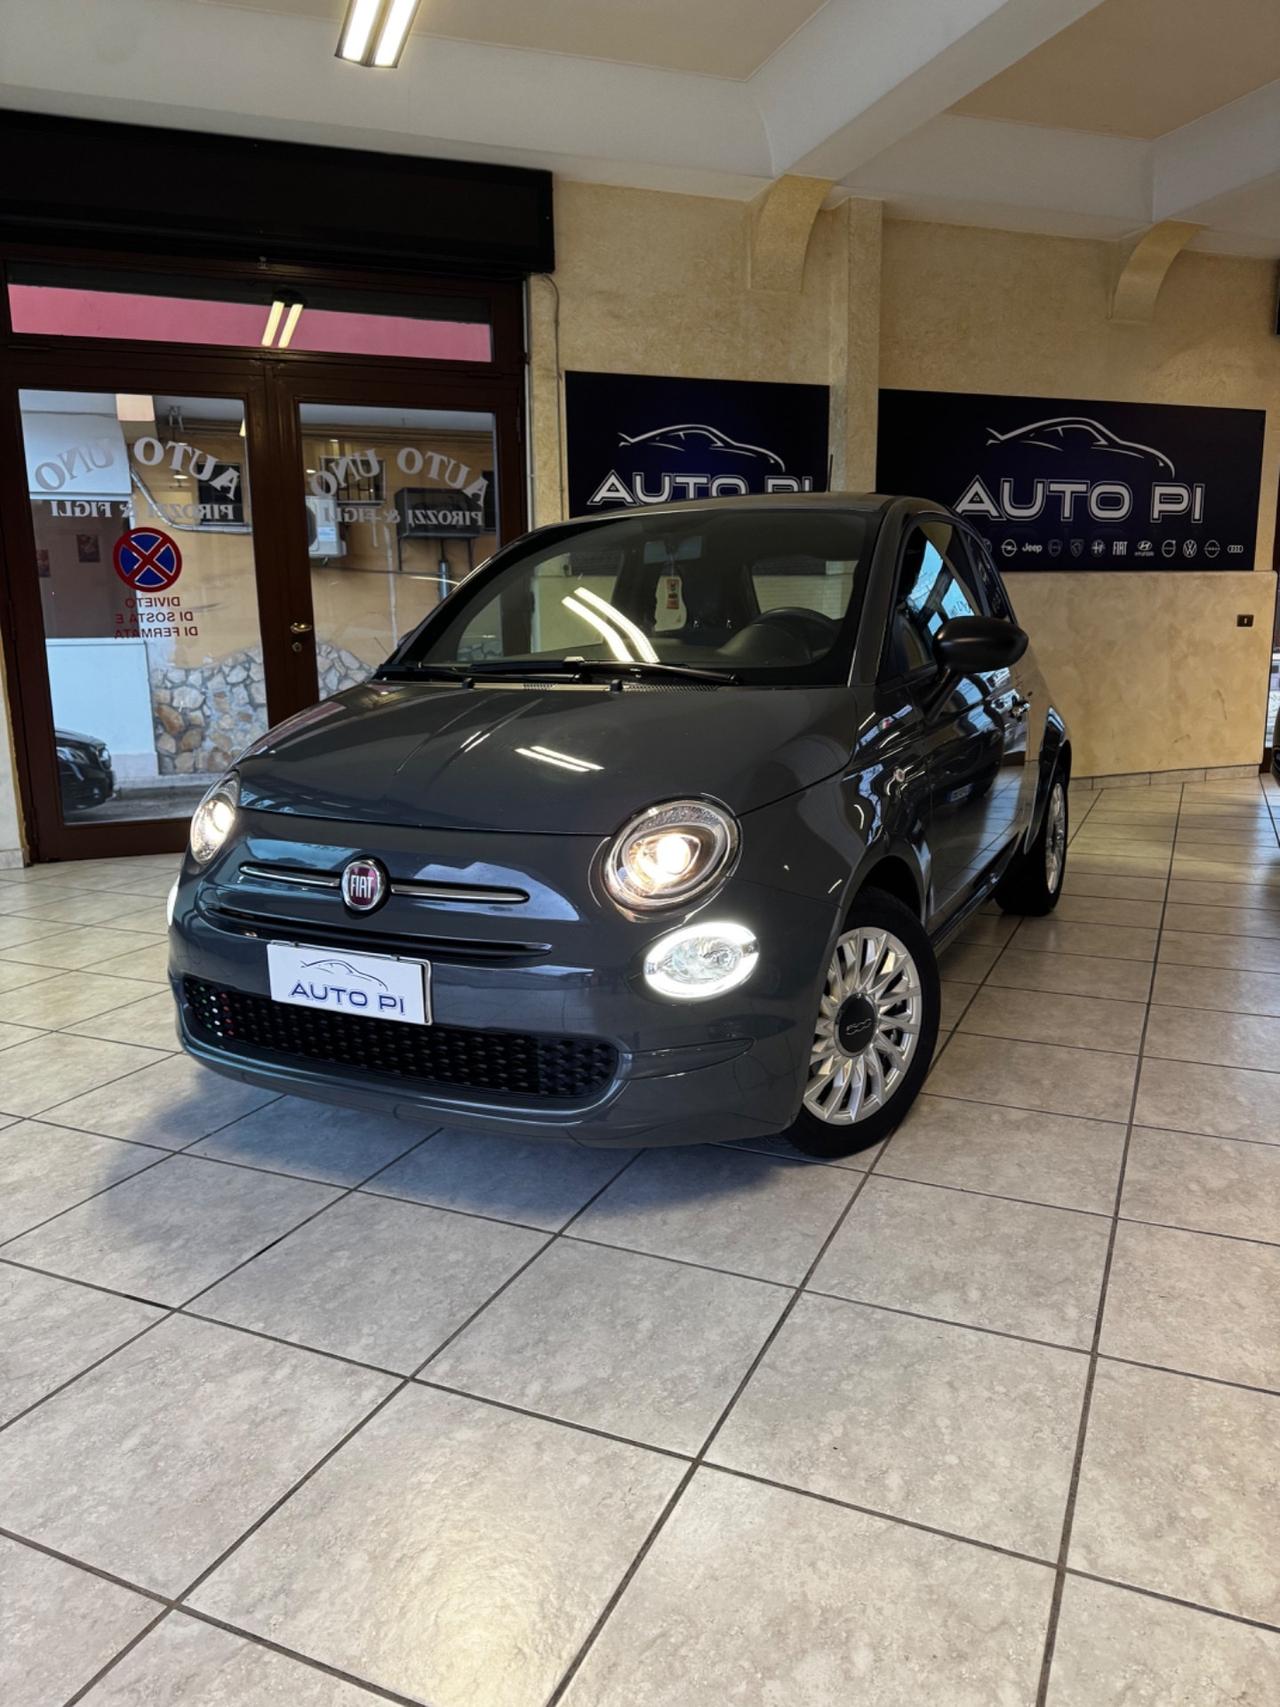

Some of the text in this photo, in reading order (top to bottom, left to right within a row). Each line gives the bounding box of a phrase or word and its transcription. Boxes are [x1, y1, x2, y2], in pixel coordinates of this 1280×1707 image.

[586, 469, 749, 507] AUTO
[952, 475, 1206, 524] AUTO PI
[350, 875, 375, 898] FIAT
[290, 982, 405, 1014] AUTO PI
